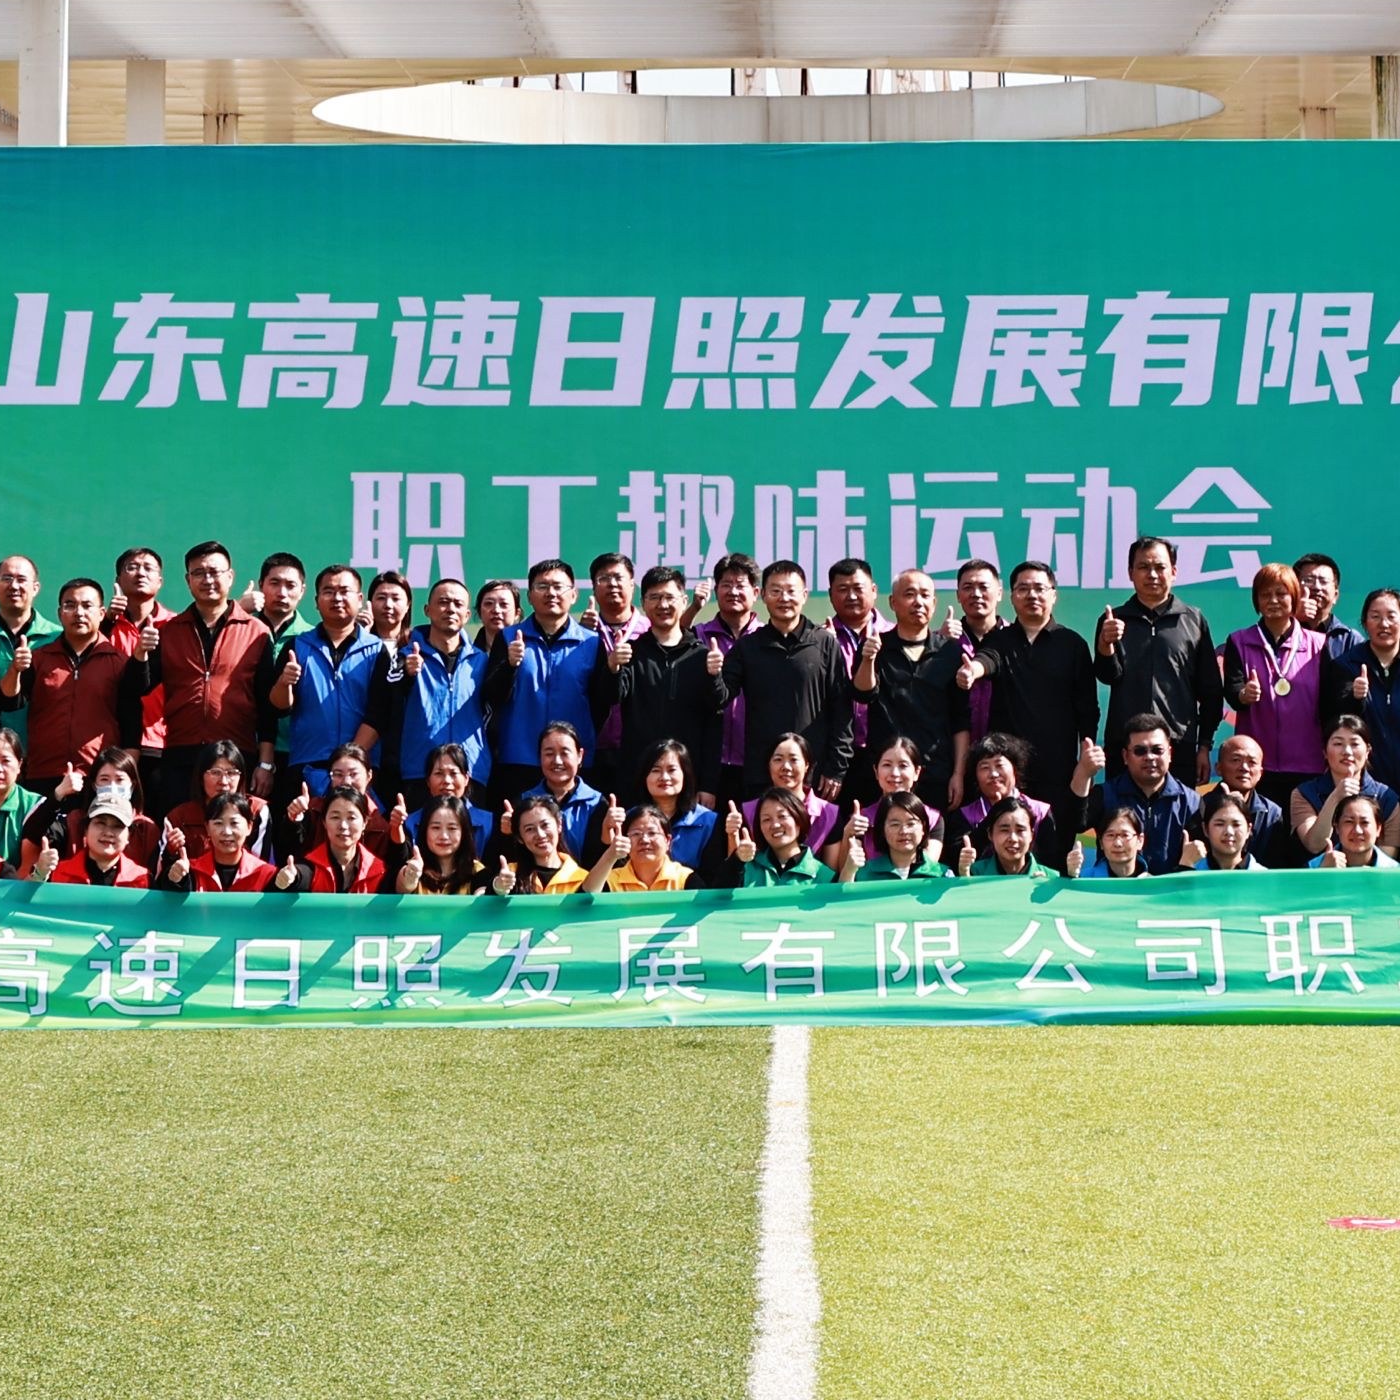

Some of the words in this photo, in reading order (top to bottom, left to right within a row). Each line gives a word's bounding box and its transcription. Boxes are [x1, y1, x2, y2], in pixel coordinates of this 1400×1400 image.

[349, 466, 1273, 592] 职工趣味运动会
